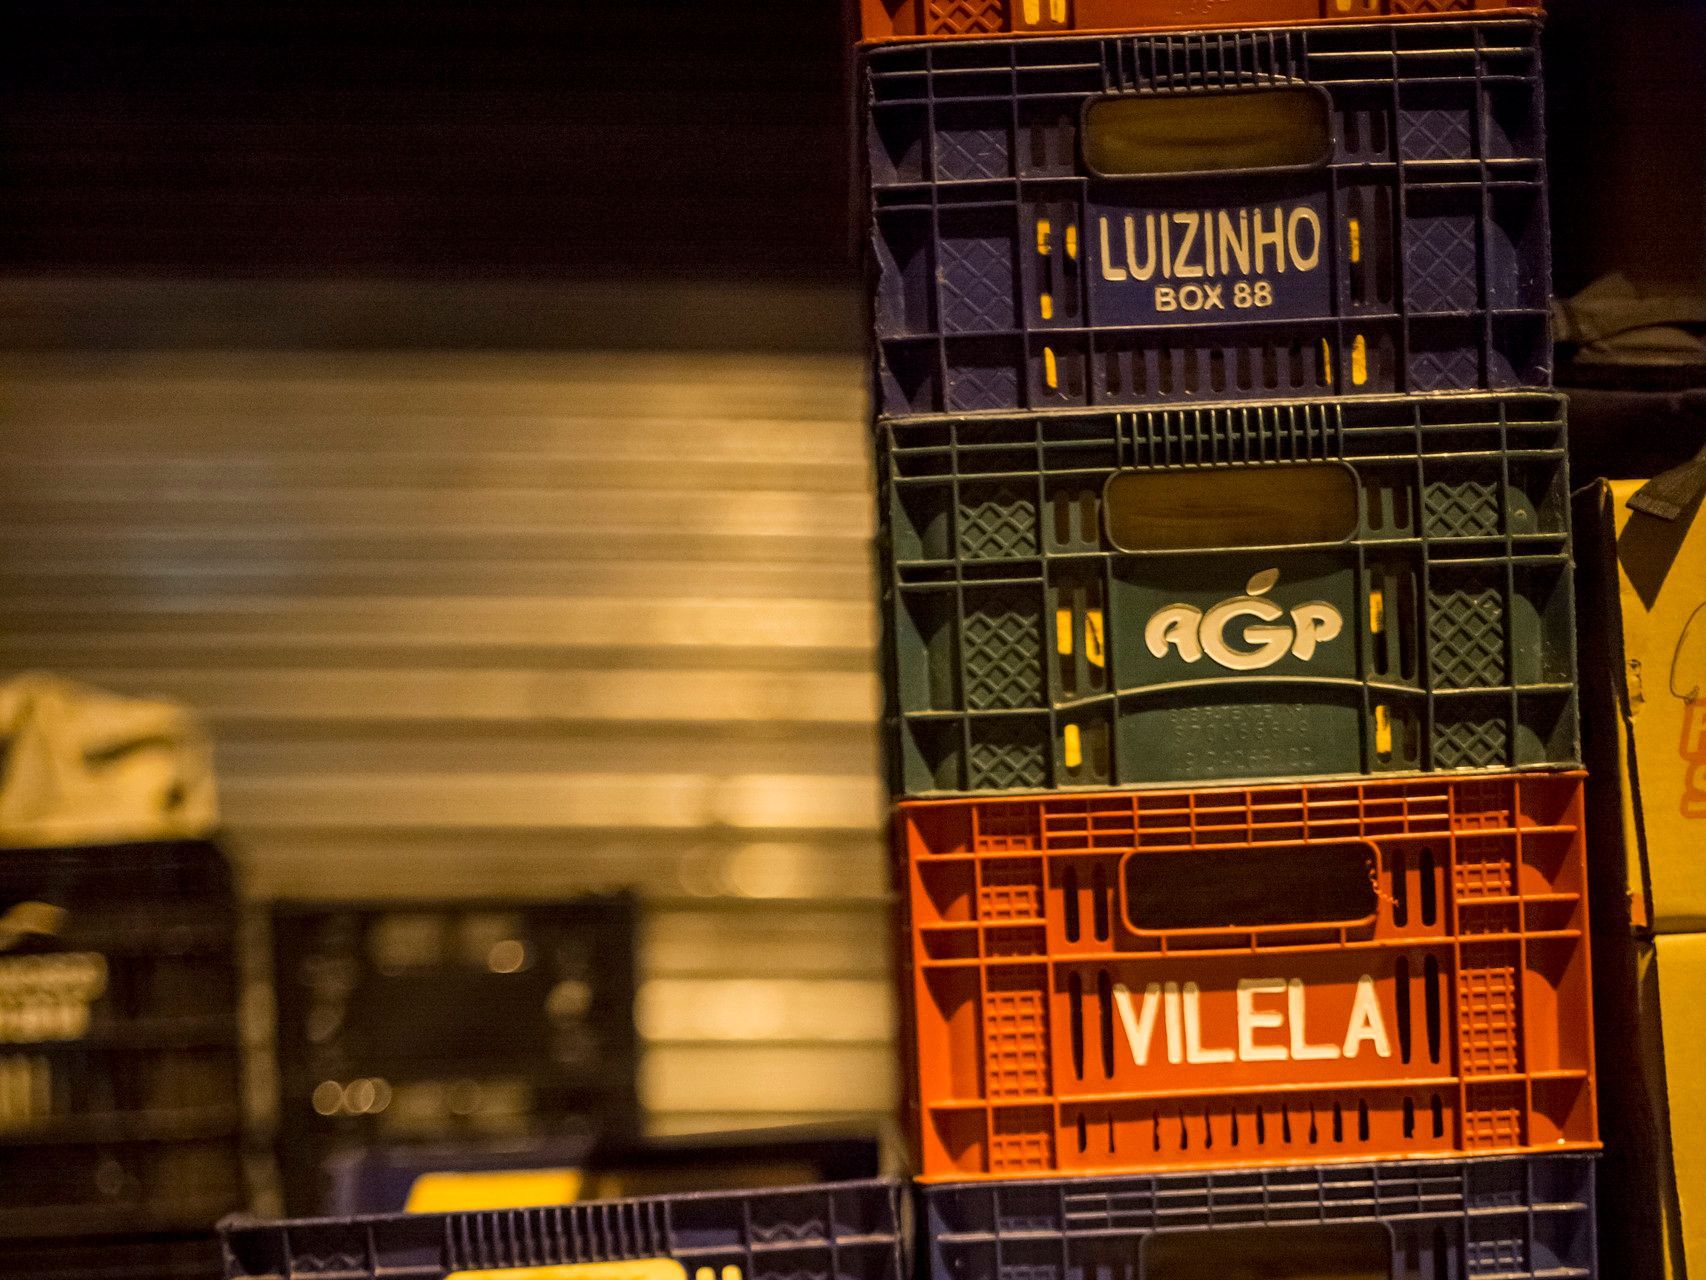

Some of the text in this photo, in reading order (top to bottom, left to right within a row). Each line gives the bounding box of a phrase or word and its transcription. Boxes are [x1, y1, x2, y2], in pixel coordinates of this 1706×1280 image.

[1099, 206, 1321, 281] LUIZINHO
[1154, 281, 1274, 312] BOX 88
[1144, 595, 1344, 671] AGP
[1113, 975, 1391, 1065] VILELA
